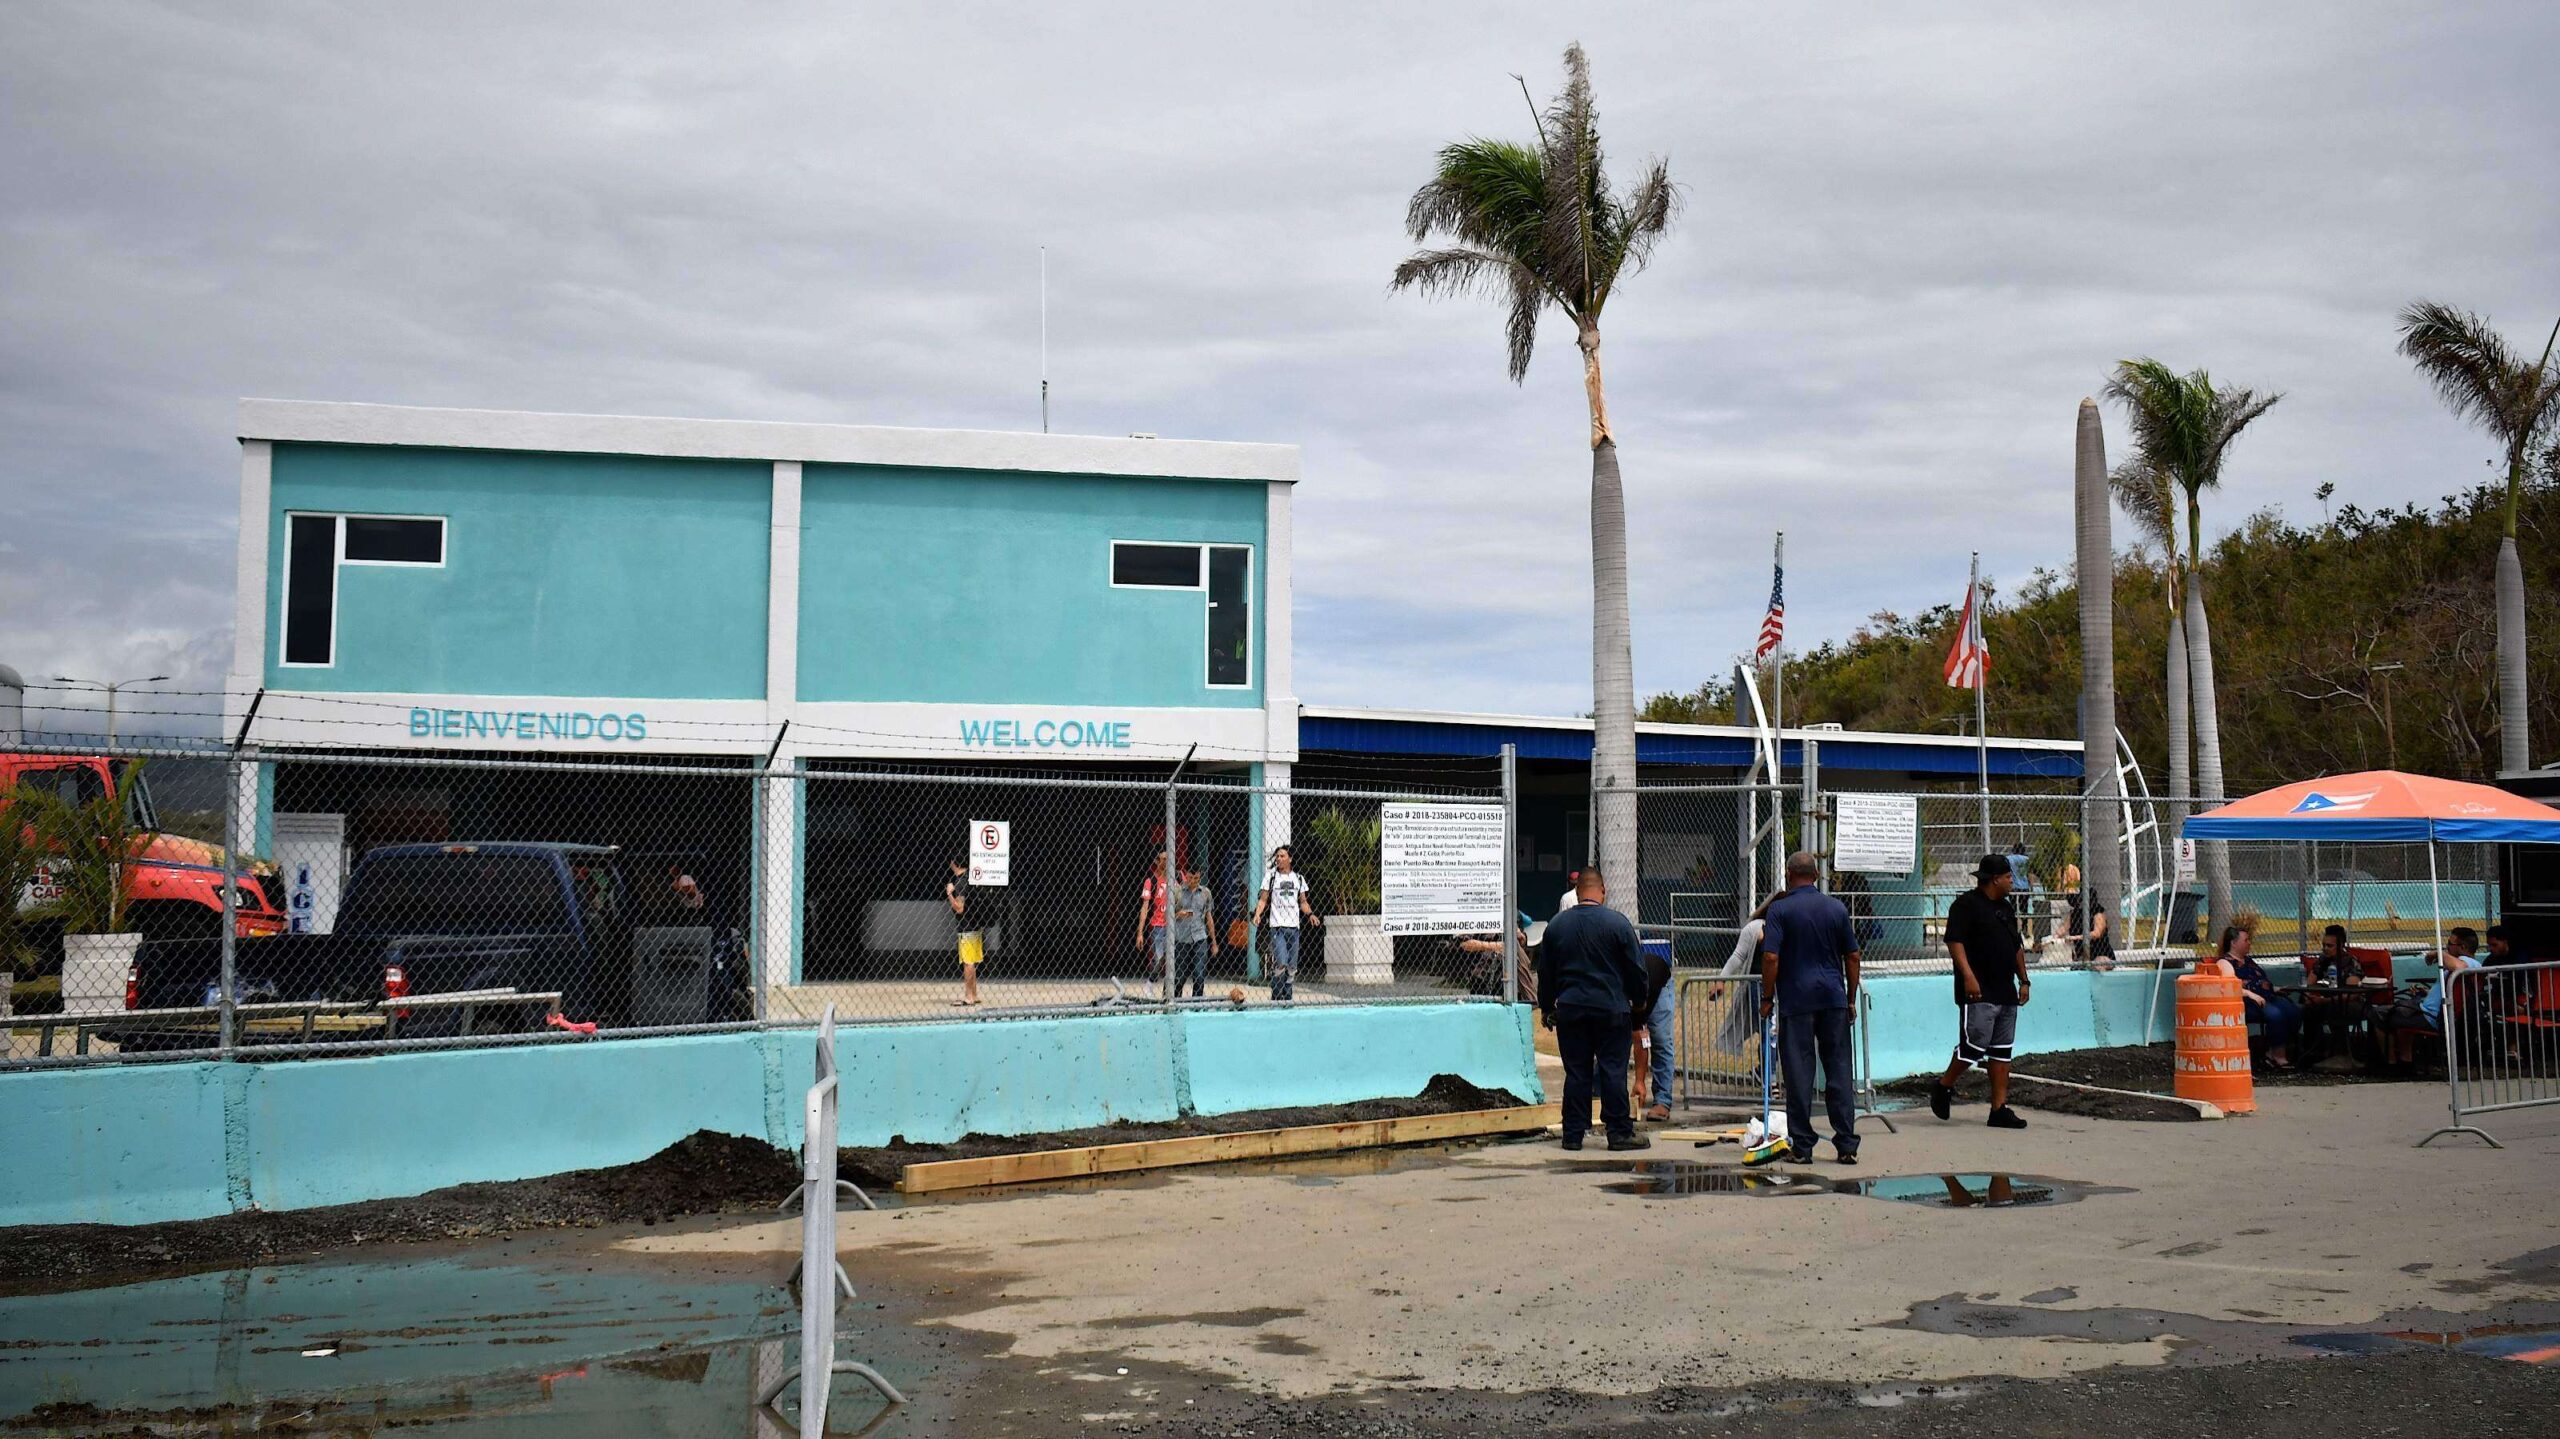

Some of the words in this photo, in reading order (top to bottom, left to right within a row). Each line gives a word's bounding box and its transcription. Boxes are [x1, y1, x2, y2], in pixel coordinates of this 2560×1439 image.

[410, 708, 647, 741] BIENVENIDOS
[960, 719, 1131, 748] WELCOME
[1384, 810, 1403, 819] Caso
[1384, 923, 1403, 932] Caso
